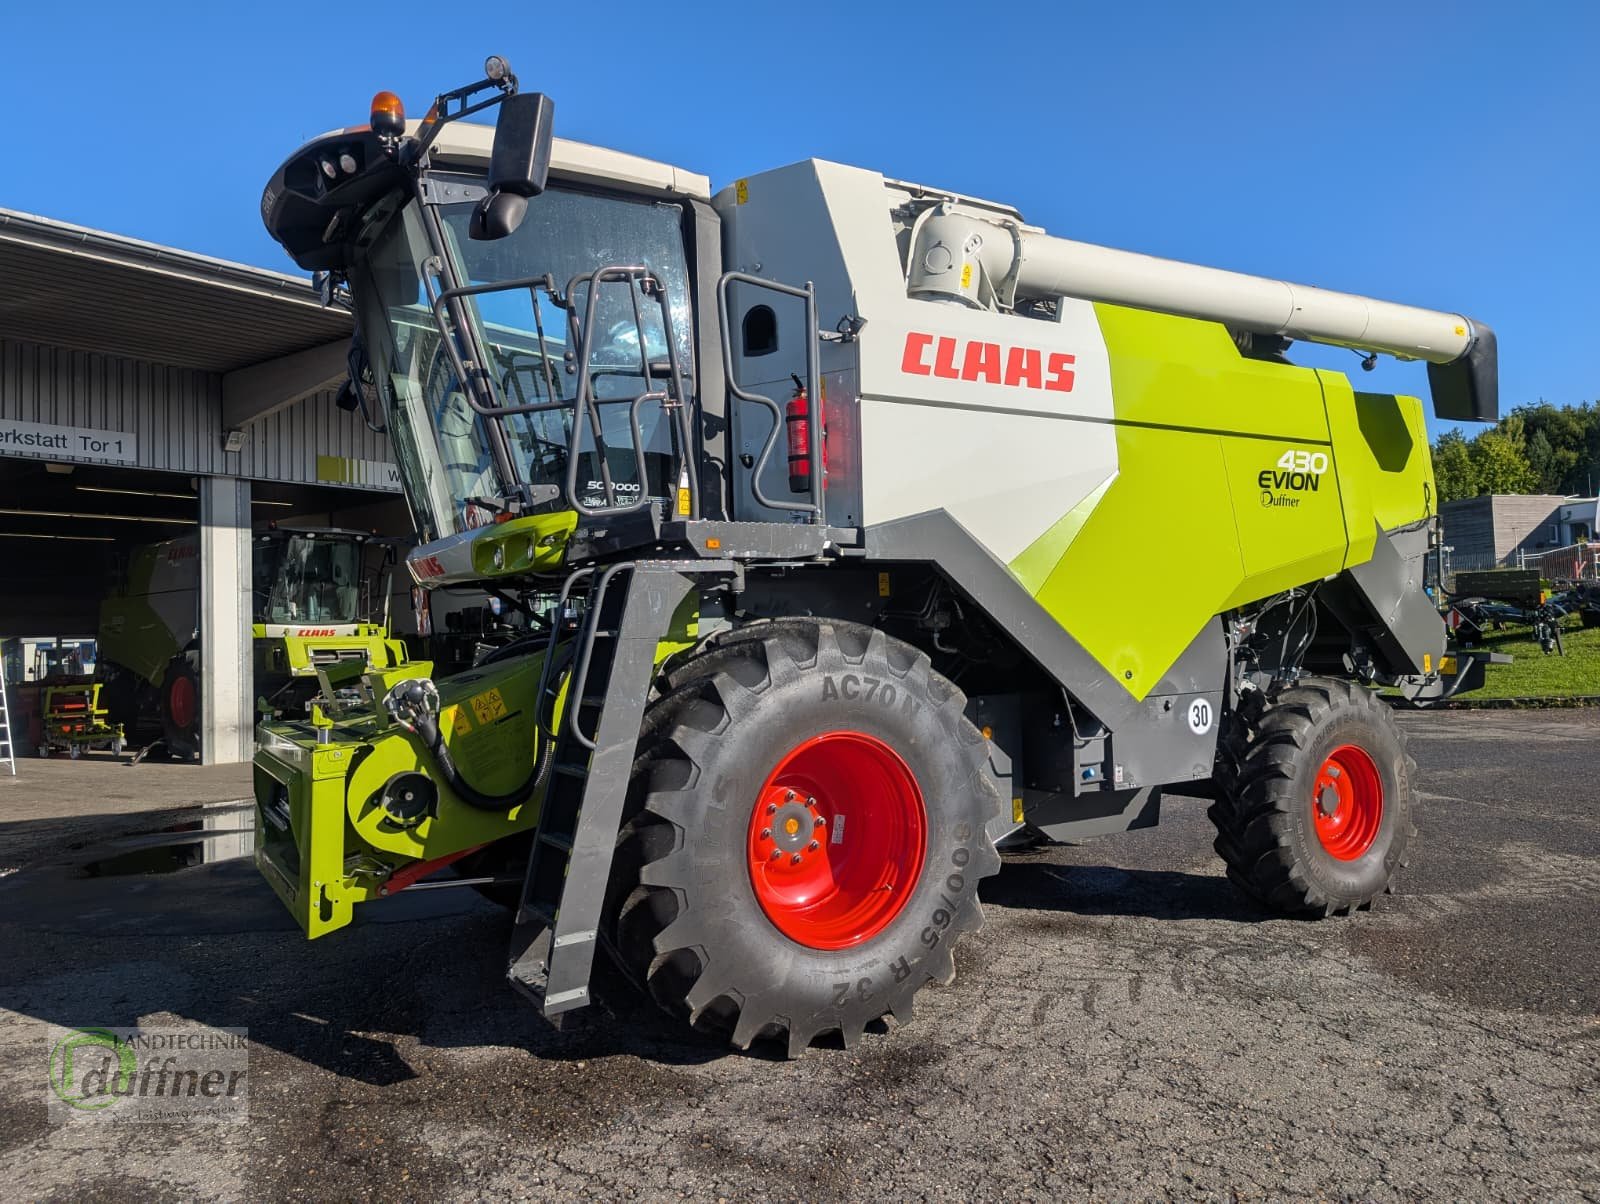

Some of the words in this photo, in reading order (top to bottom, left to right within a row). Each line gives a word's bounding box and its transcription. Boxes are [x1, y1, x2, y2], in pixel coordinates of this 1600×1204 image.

[901, 331, 1076, 392] CLAAS
[79, 435, 109, 453] Tor
[115, 439, 122, 454] 1
[1277, 449, 1328, 475] 430
[1258, 470, 1320, 491] EVION
[1261, 490, 1300, 508] Duffner
[297, 629, 336, 637] CLAAS
[822, 674, 896, 708] AC70
[1193, 704, 1208, 727] 30
[889, 956, 911, 983] R
